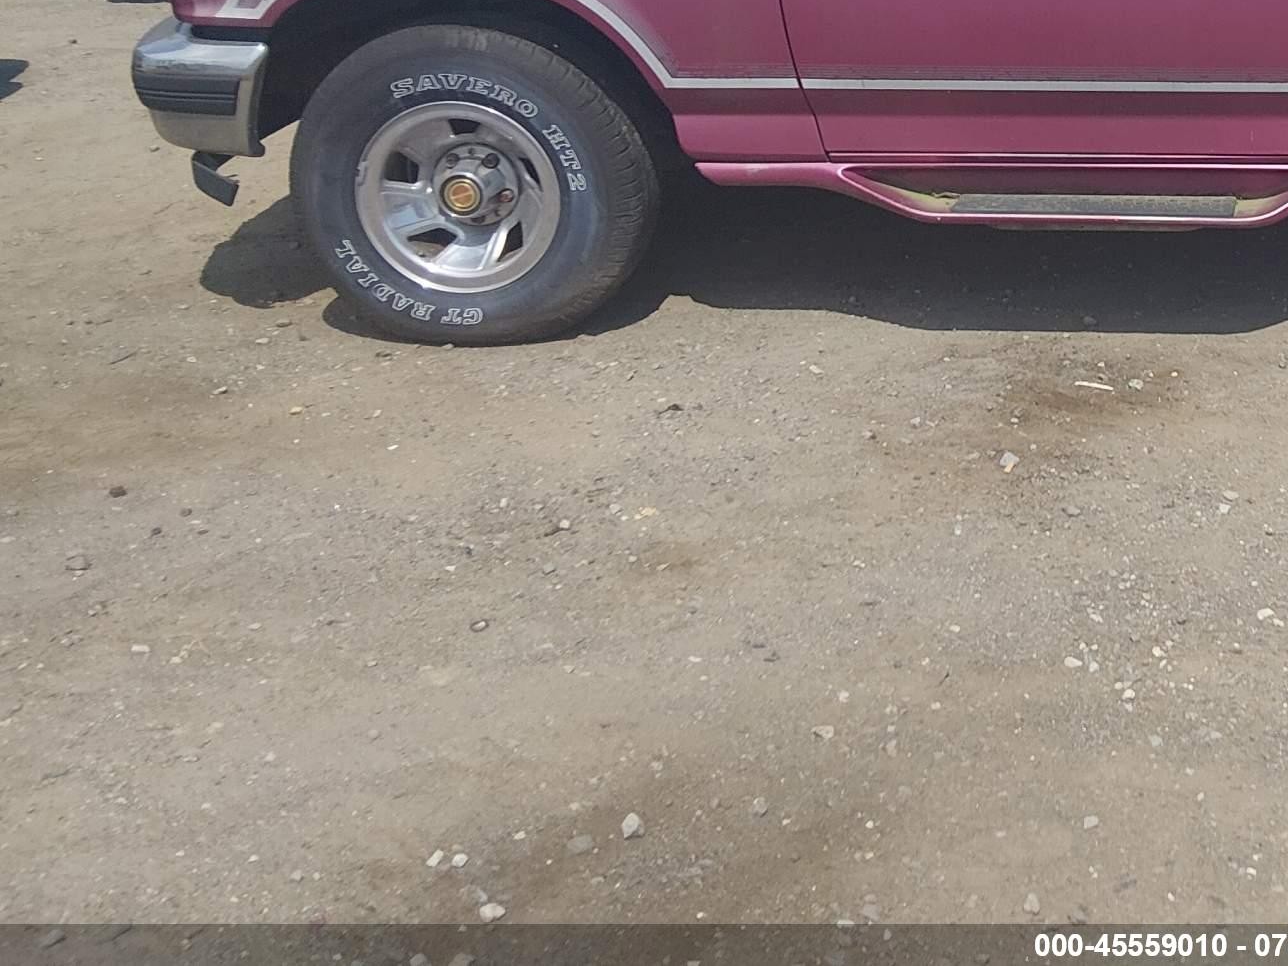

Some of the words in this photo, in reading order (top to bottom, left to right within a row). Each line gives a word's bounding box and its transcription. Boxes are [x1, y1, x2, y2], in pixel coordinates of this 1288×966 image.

[390, 74, 540, 120] SAVERO
[541, 123, 588, 192] HT2
[335, 239, 437, 322] RADIAL
[440, 307, 484, 326] GT
